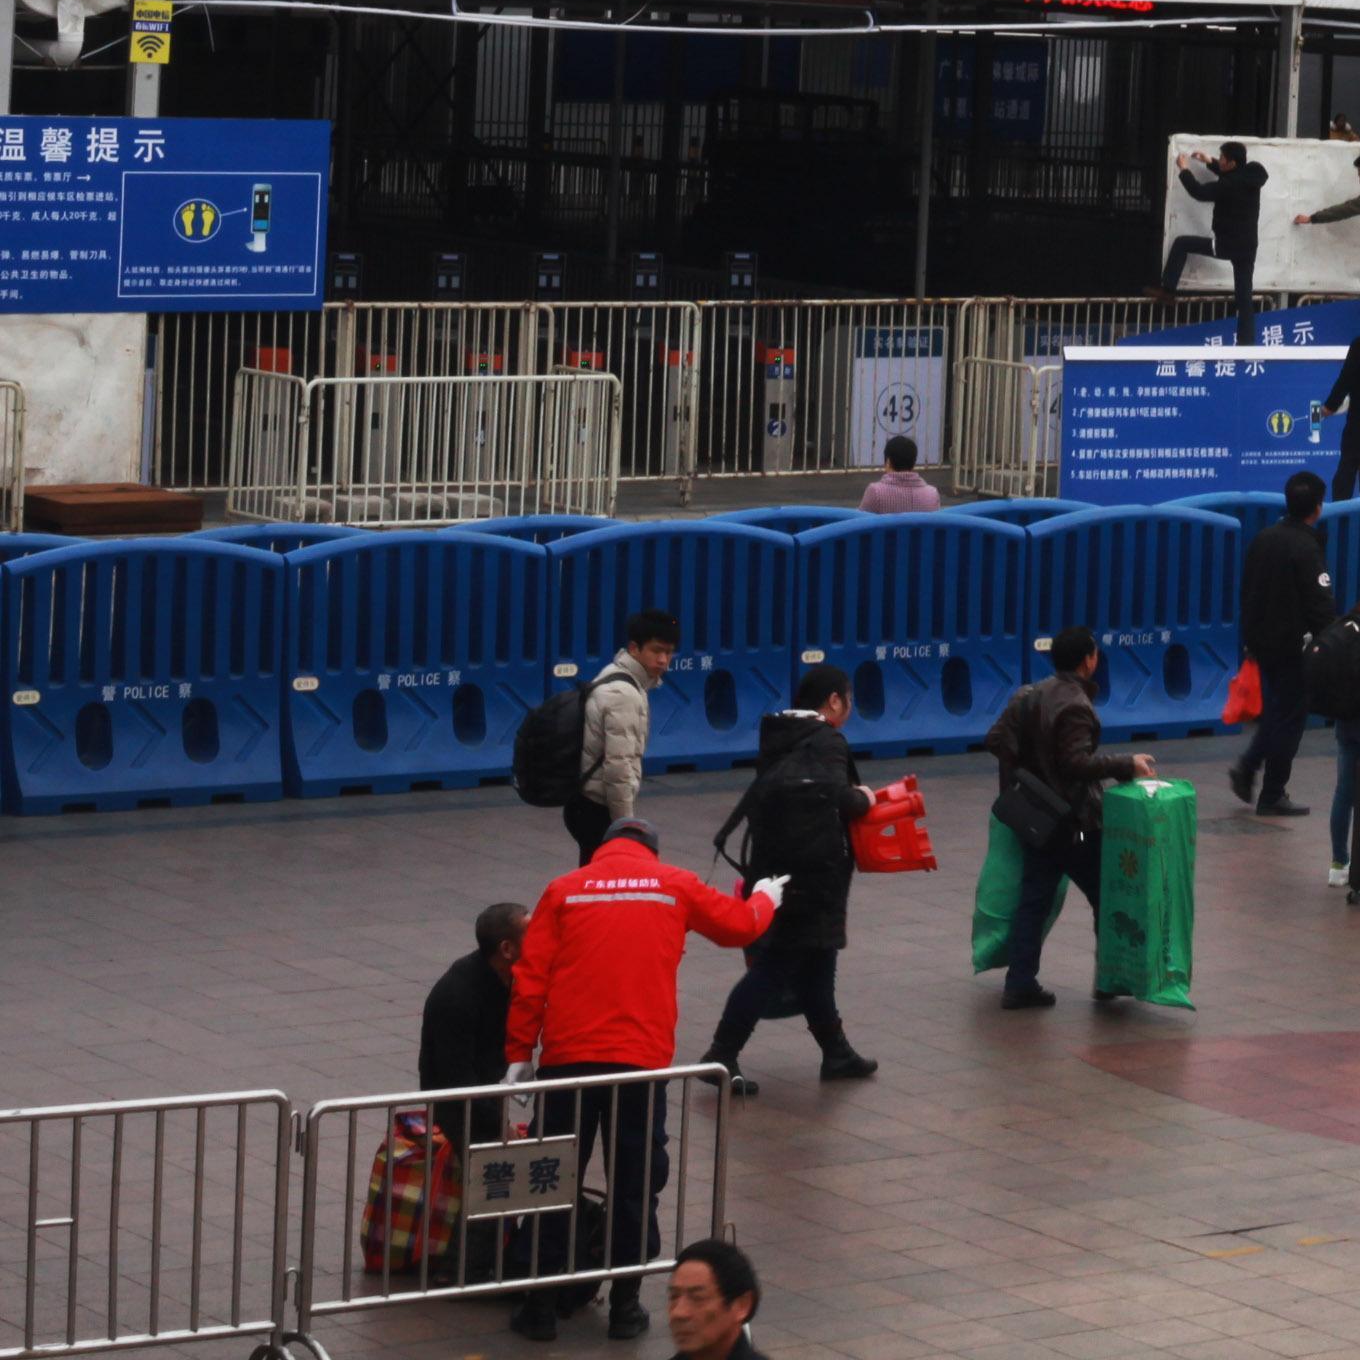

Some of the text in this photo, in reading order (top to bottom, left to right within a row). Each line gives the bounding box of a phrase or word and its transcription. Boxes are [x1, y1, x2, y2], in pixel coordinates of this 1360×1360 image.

[0, 127, 166, 163] 温馨提示
[883, 395, 915, 423] 43
[1119, 631, 1156, 647] POLICE
[876, 642, 951, 661] 警 POLICE 察
[667, 655, 714, 672] LICE 察
[377, 670, 461, 691] 警 POLICE 察
[102, 682, 193, 702] 警 POLICE 察
[482, 1156, 561, 1200] 警察
